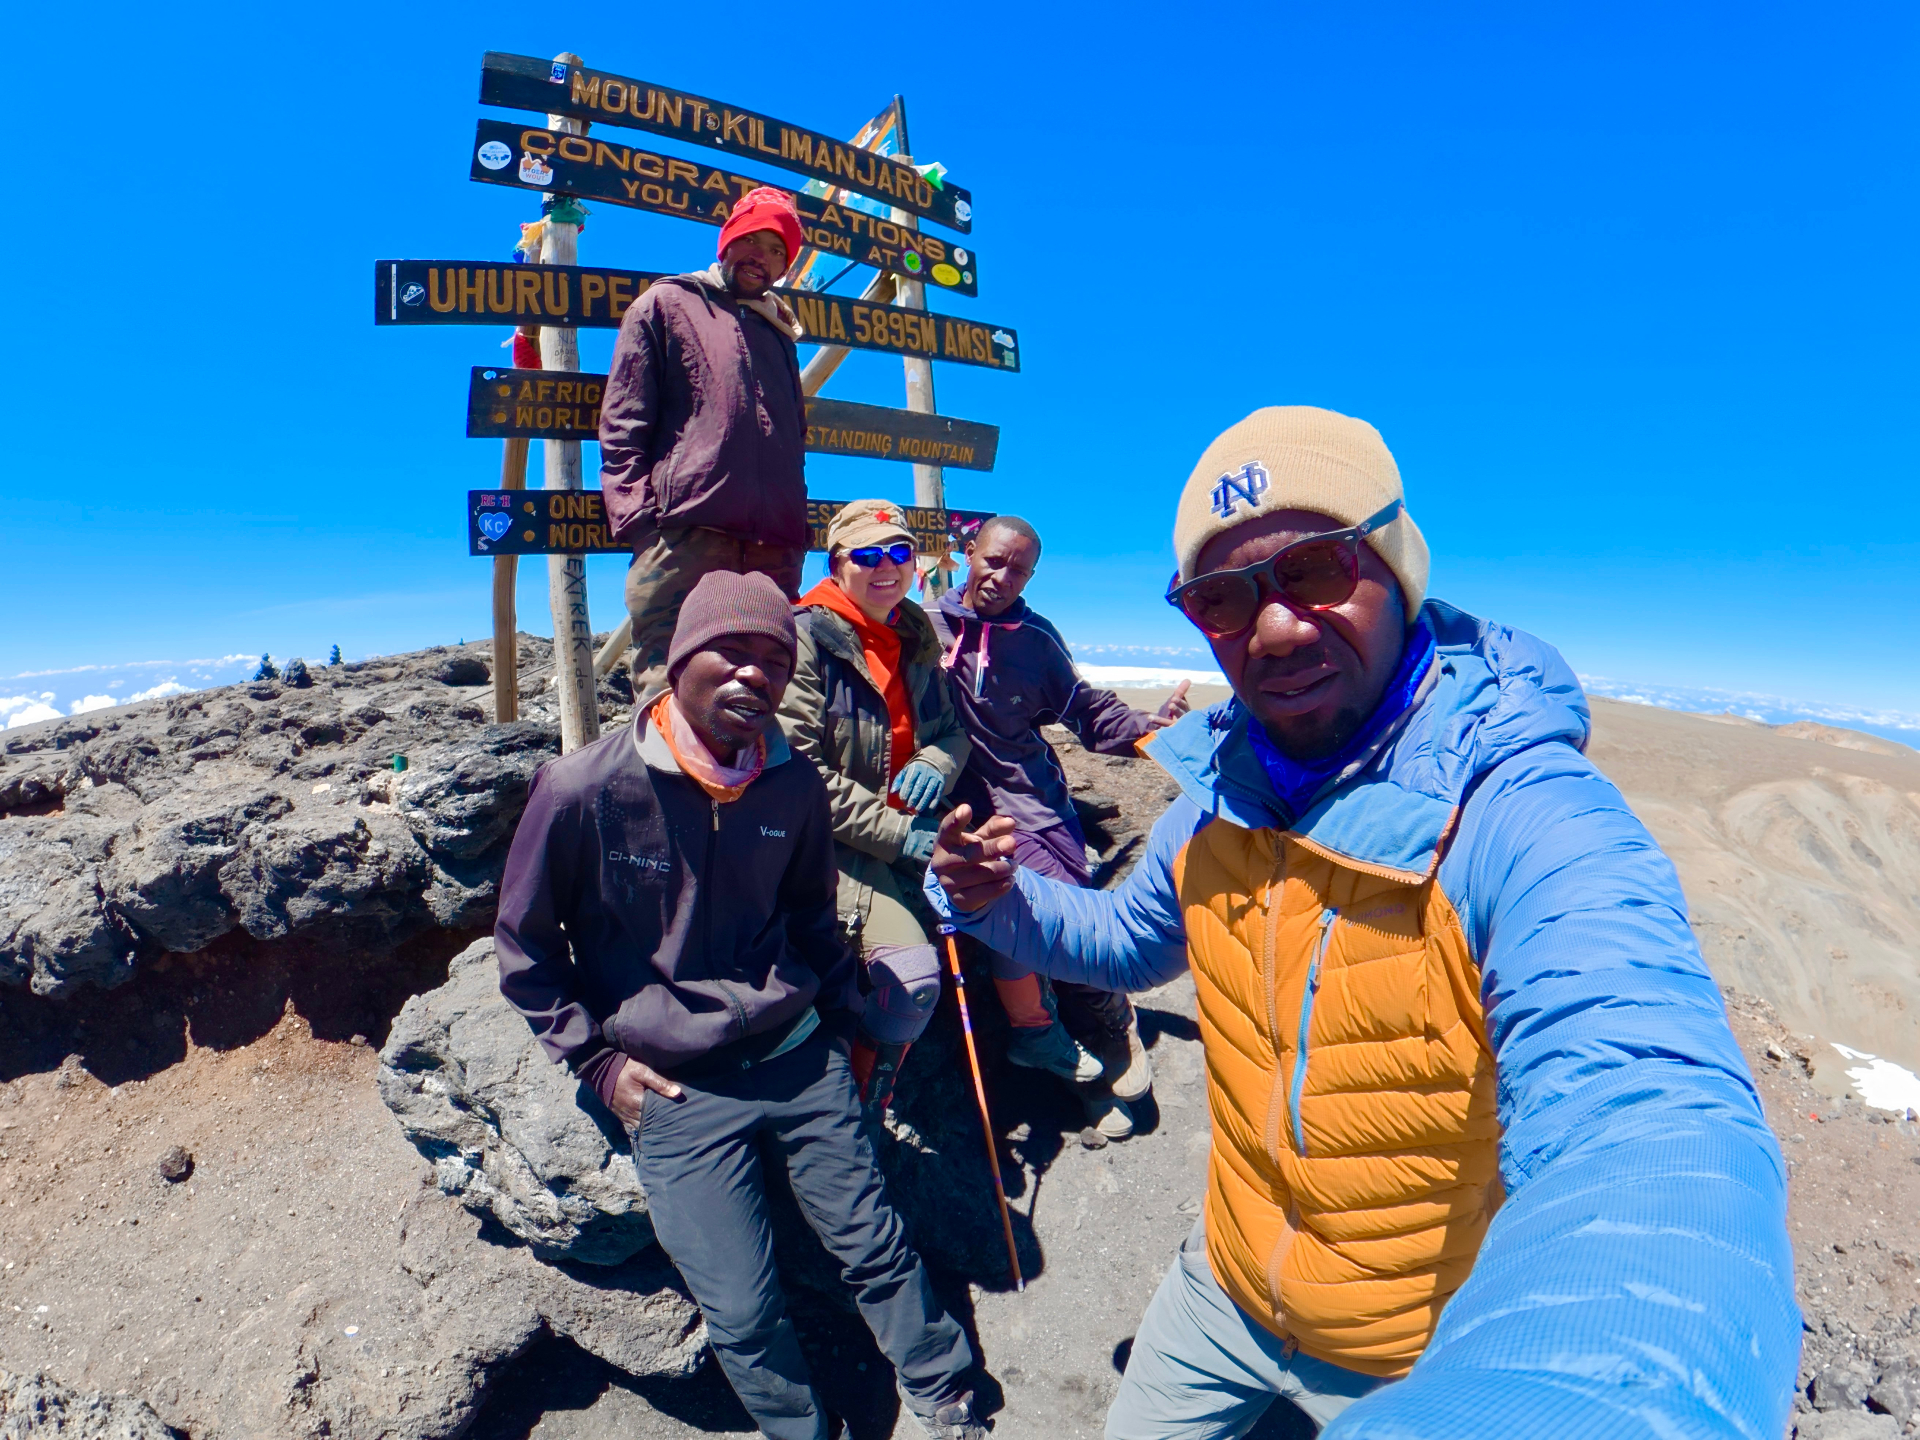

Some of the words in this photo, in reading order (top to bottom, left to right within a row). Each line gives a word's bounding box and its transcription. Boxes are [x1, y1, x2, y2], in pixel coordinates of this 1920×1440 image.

[572, 71, 709, 132] MOUNT
[723, 109, 934, 208] KILIMANJARO
[520, 130, 946, 261] CONGRATLATIONS
[622, 178, 689, 210] YOU
[868, 245, 898, 265] AT
[428, 267, 570, 316] UHURU
[853, 305, 938, 354] 5895M
[944, 321, 1000, 366] AMSL
[805, 425, 892, 453] STANDING
[898, 436, 974, 464] MOUNTAIN
[484, 518, 504, 533] KC
[549, 494, 600, 519] ONE
[549, 523, 631, 548] WORL
